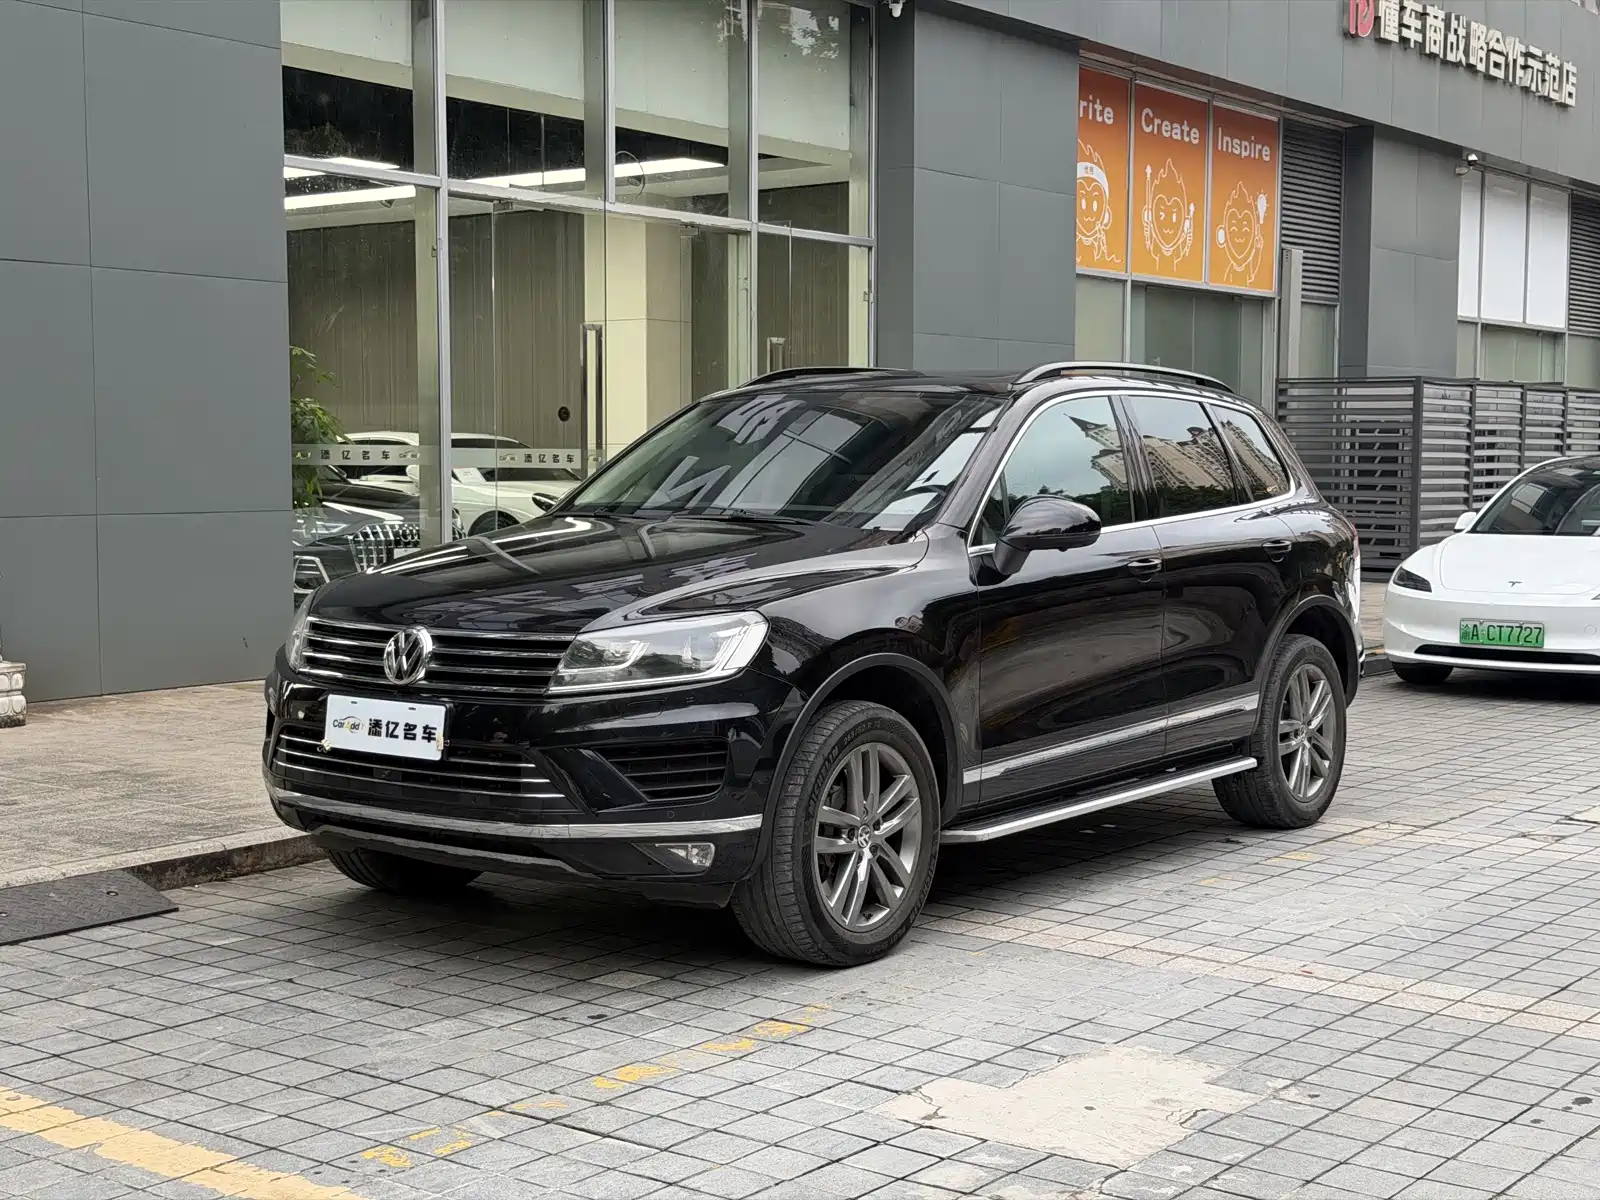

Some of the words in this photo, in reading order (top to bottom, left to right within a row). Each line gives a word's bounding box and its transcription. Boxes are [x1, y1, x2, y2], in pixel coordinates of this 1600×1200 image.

[1141, 107, 1200, 144] Create
[1217, 127, 1271, 162] Inspire
[320, 449, 390, 460] 添亿名车
[524, 453, 575, 464] 添亿名车
[368, 718, 437, 743] 添亿名车
